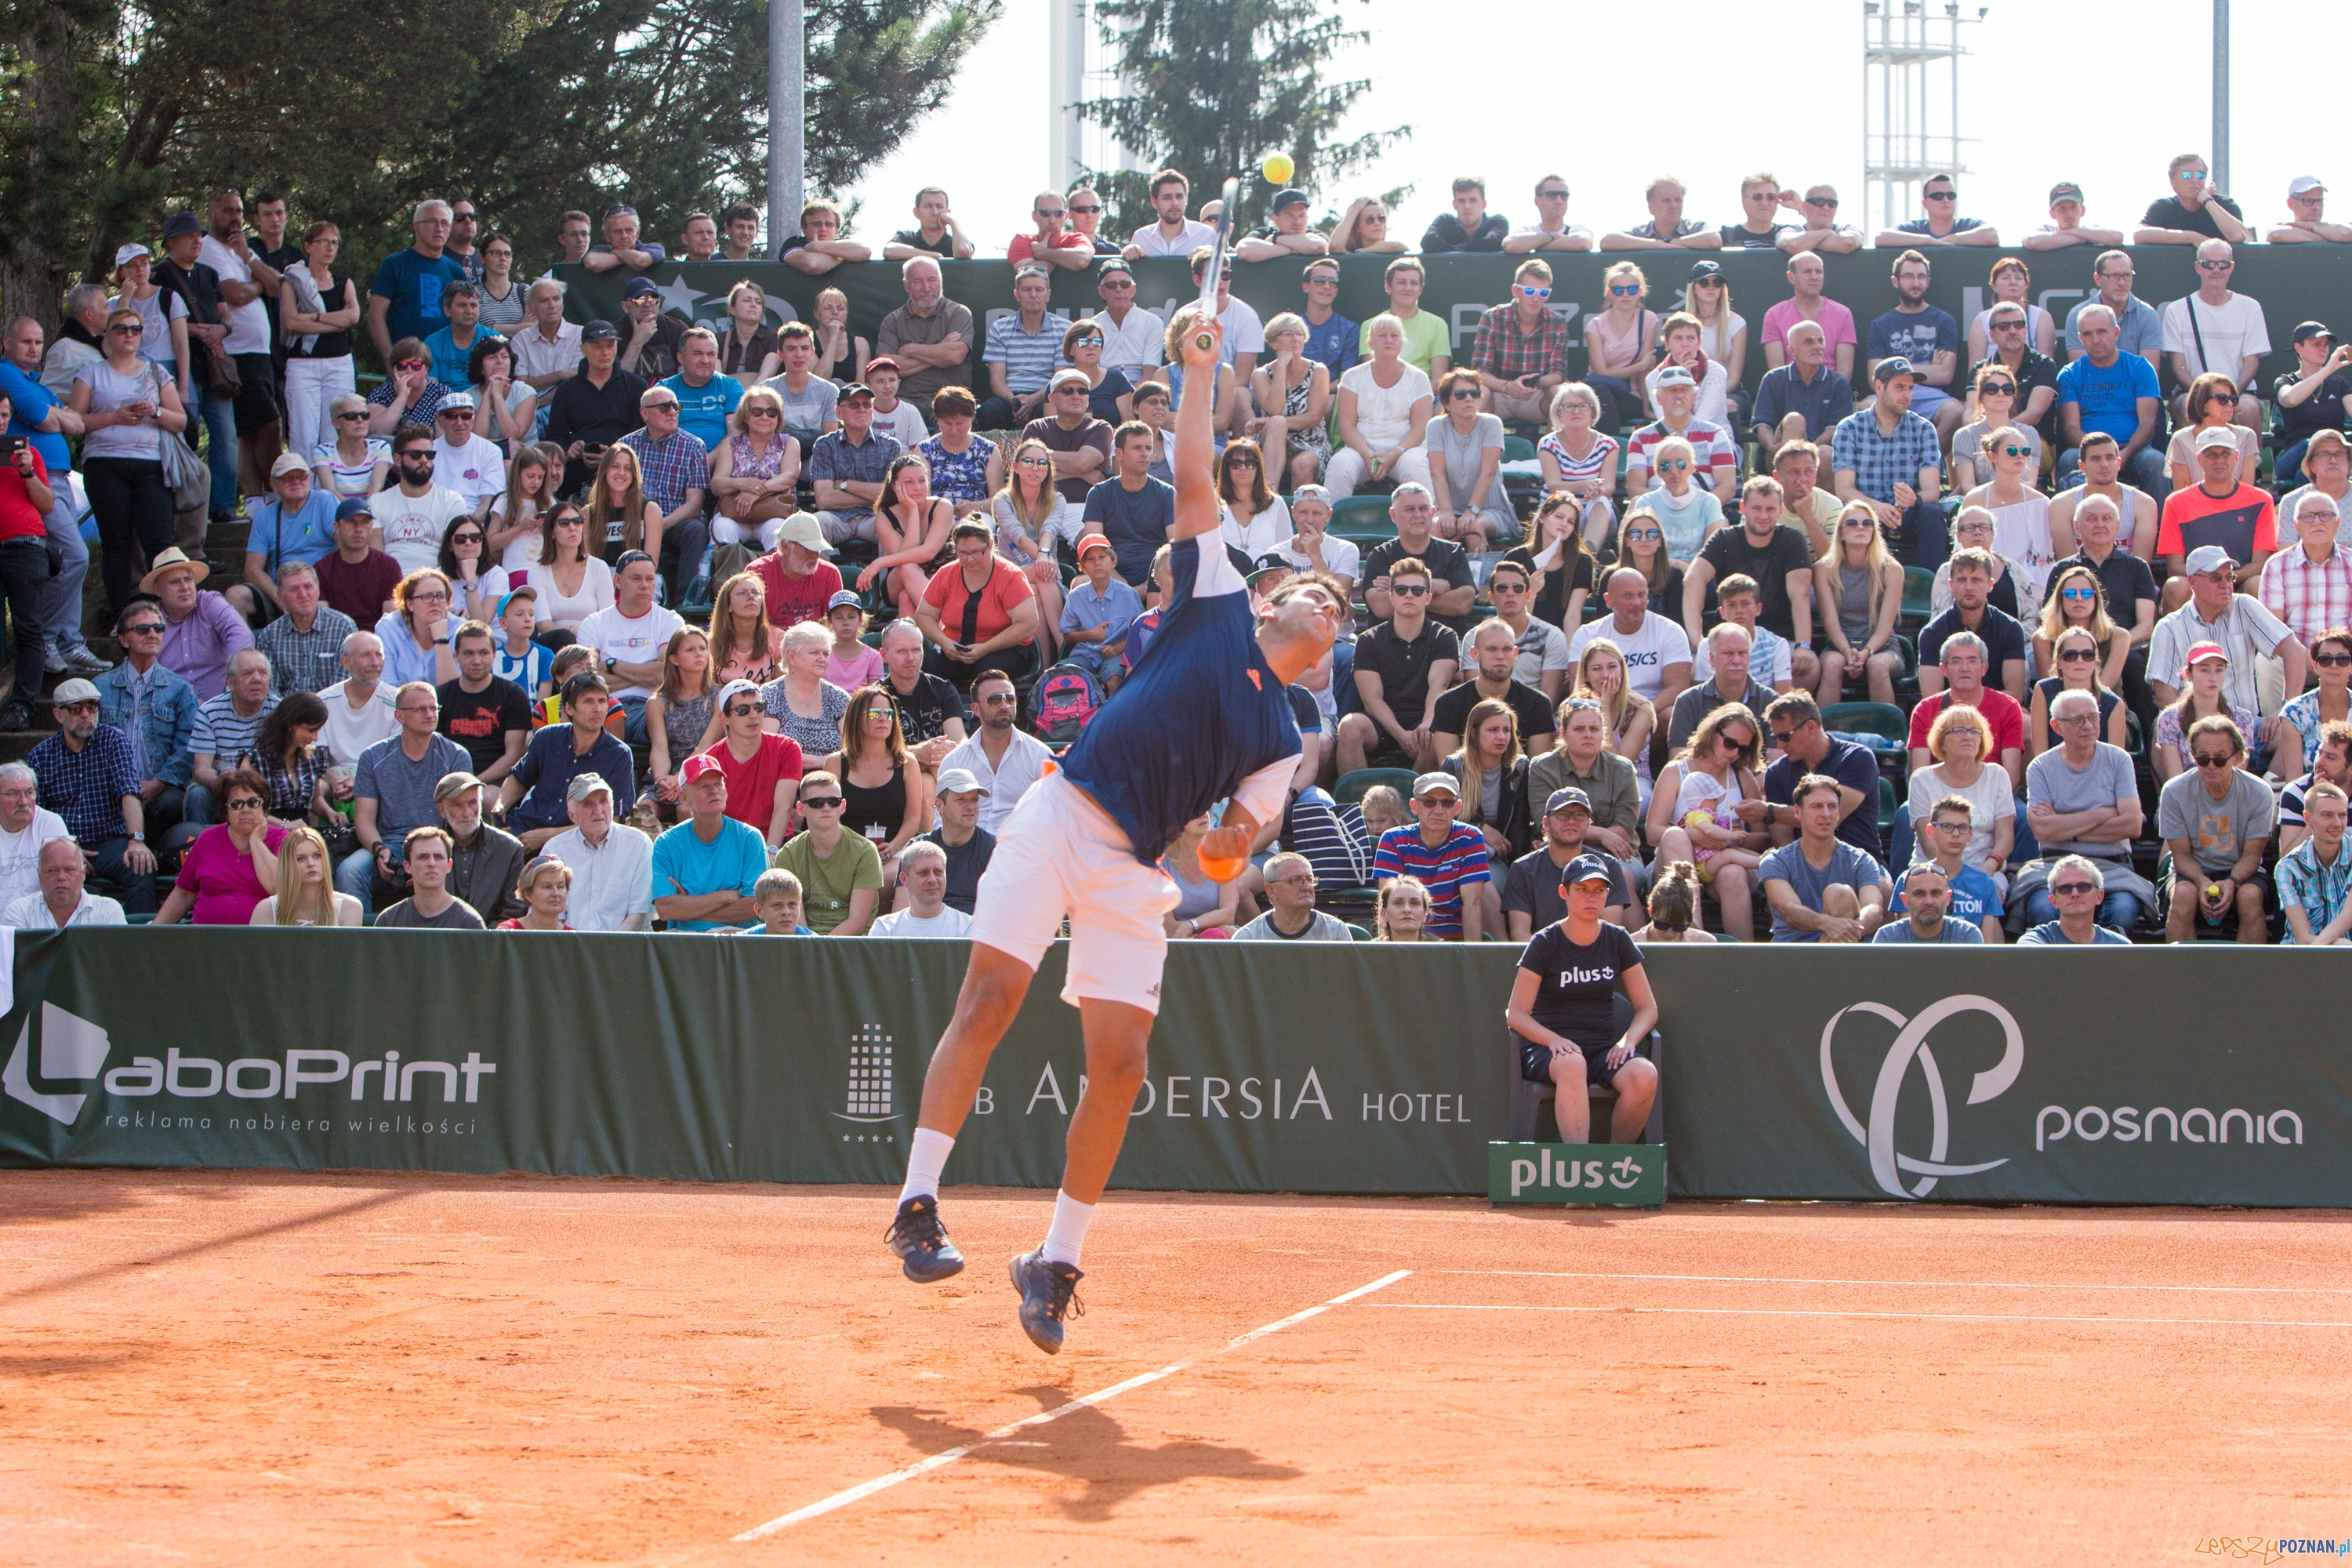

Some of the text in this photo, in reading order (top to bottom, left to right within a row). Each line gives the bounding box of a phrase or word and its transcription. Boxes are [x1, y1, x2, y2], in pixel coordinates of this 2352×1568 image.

[403, 528, 420, 536] NY
[1954, 900, 1983, 913] TTON
[1560, 967, 1601, 988] plus
[1025, 1060, 1333, 1120] ADERSIA
[1363, 1093, 1472, 1122] HOTEL
[105, 1110, 475, 1134] reklama nabiera wielkości
[2036, 1105, 2303, 1152] posnania
[1511, 1149, 1604, 1196] plus
